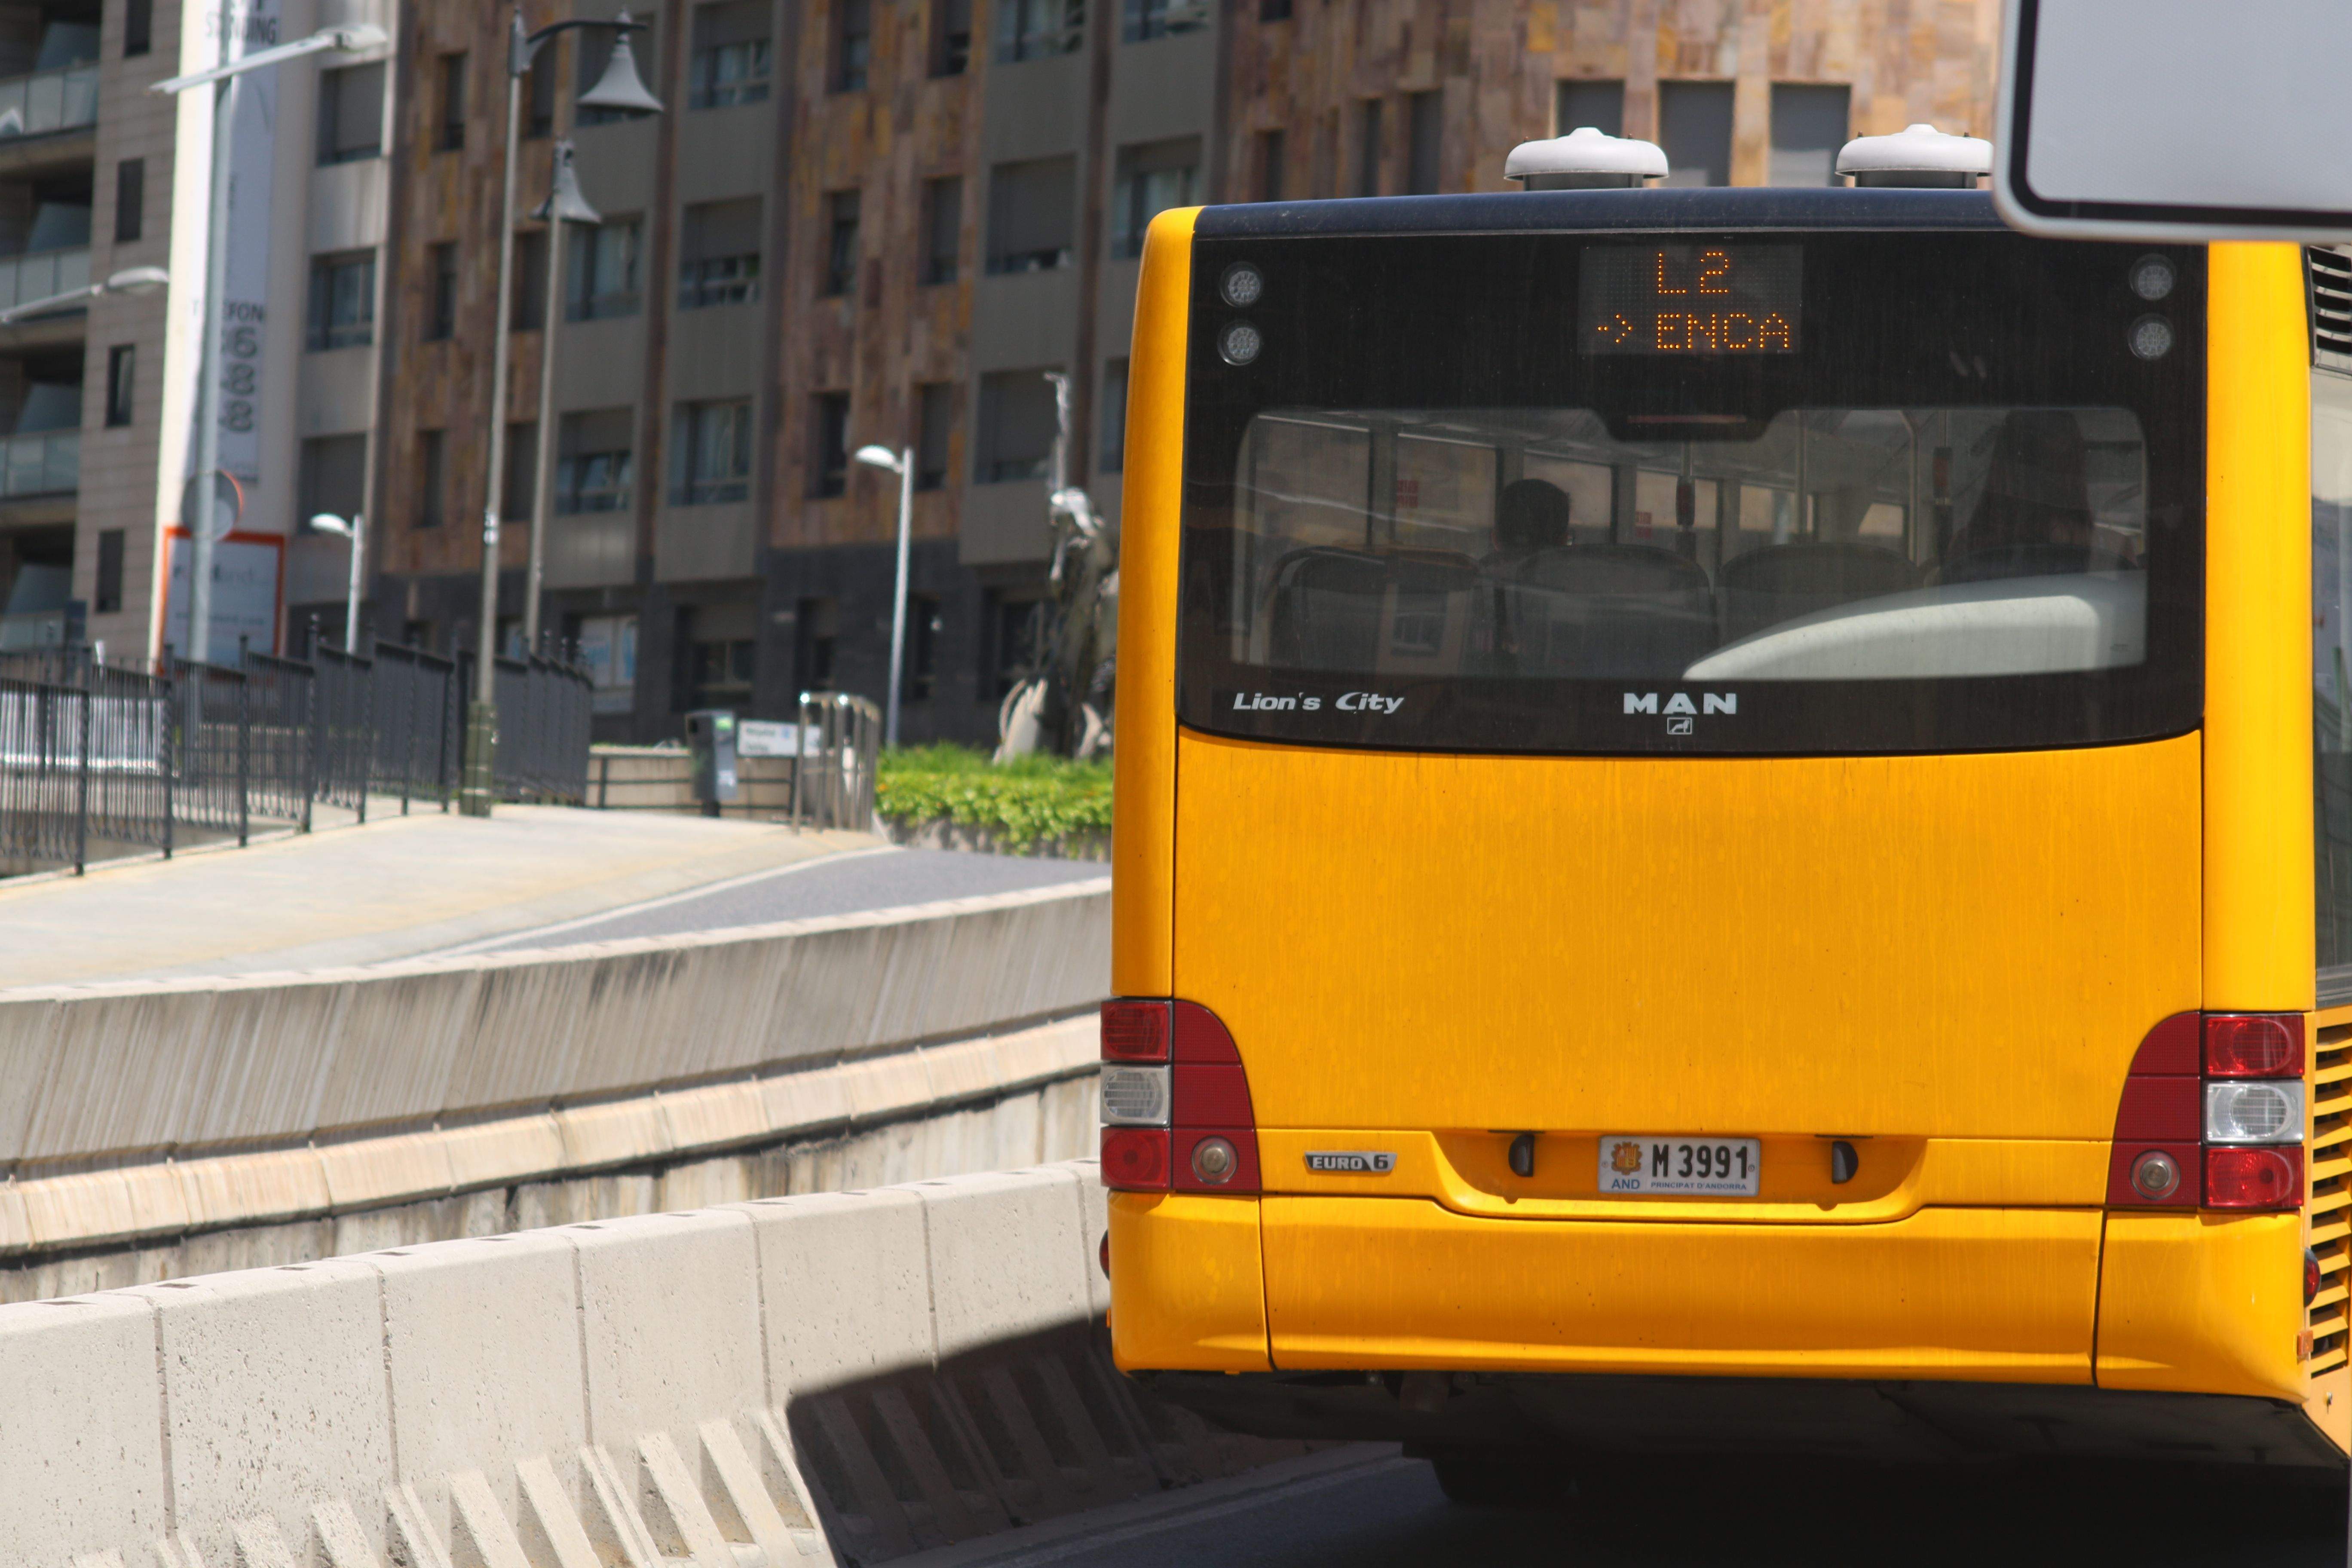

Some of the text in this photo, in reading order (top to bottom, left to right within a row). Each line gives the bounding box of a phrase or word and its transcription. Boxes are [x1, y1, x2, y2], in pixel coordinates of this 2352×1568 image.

[1657, 313, 1789, 349] ENCA
[1233, 691, 1405, 714] Lion's City
[1623, 692, 1736, 714] MAN
[1312, 1154, 1388, 1170] EURO 6
[1611, 1178, 1641, 1190] AND
